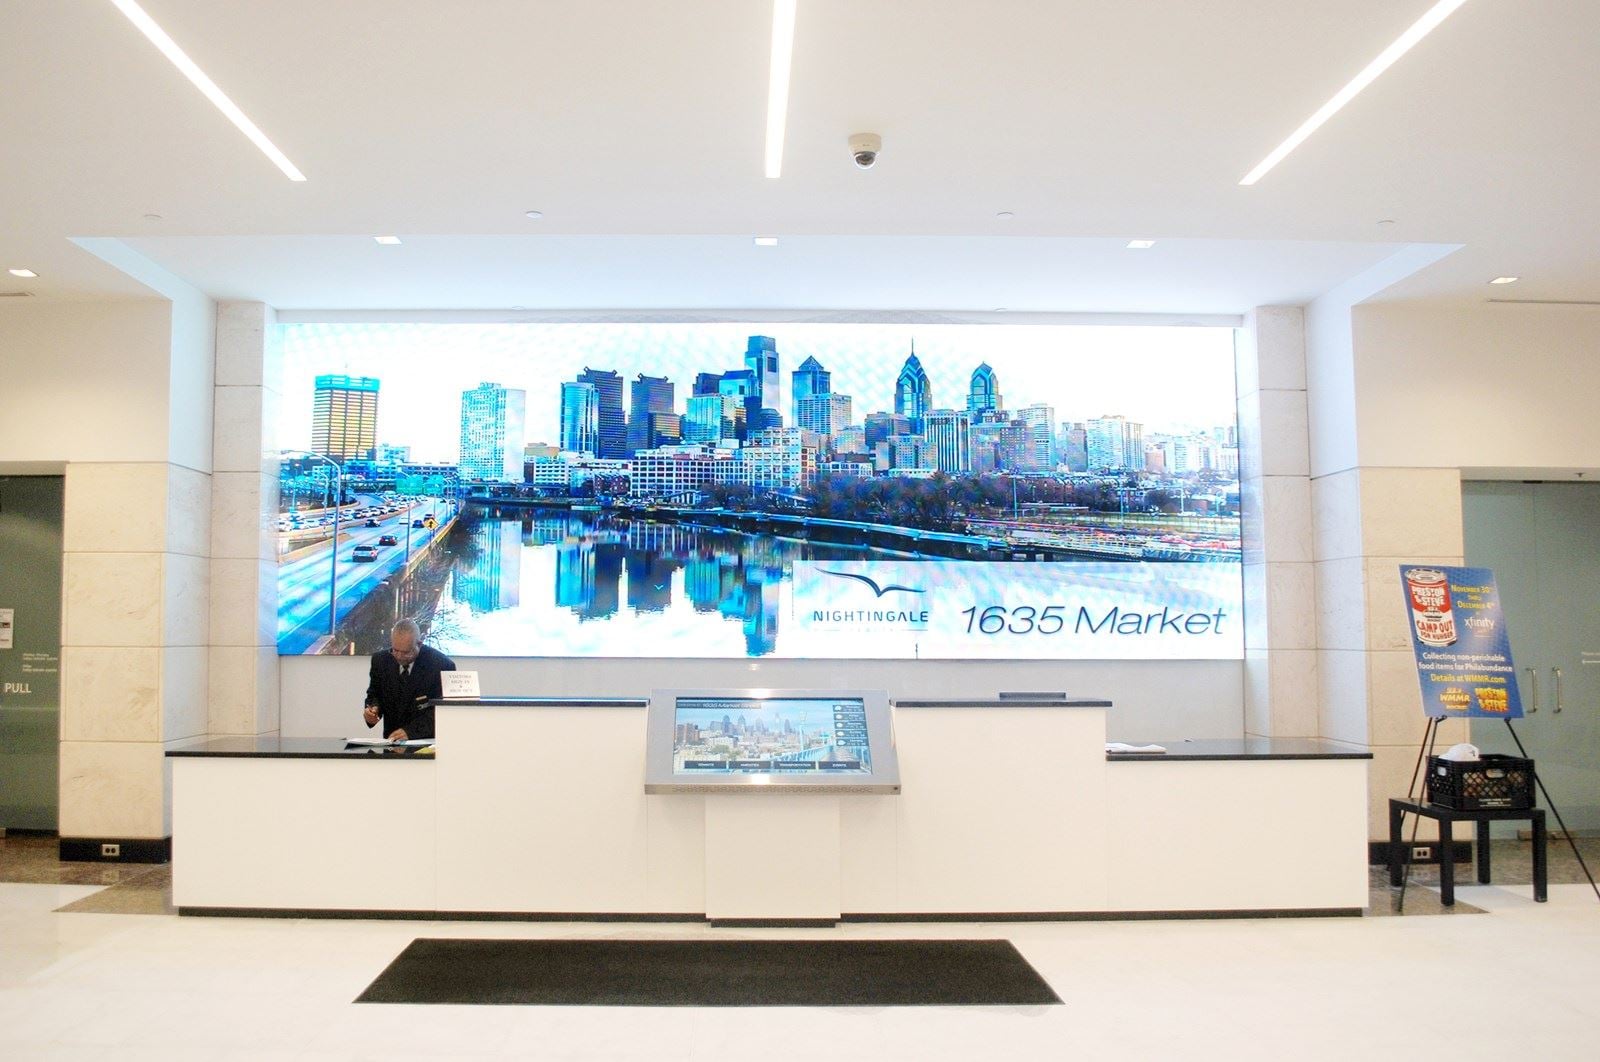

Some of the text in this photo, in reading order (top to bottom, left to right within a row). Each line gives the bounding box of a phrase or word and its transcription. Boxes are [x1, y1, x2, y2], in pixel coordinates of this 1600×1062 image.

[813, 610, 929, 622] NIGHTINGALE
[961, 605, 1227, 635] 1635 Market
[1416, 620, 1453, 632] CAMP OUT
[1423, 652, 1456, 661] Collecting
[1418, 661, 1435, 670] food
[1465, 663, 1513, 672] Philabundance
[1430, 673, 1455, 682] Details
[1456, 674, 1465, 682] at
[4, 682, 32, 693] PULL
[1440, 693, 1471, 702] WMMR
